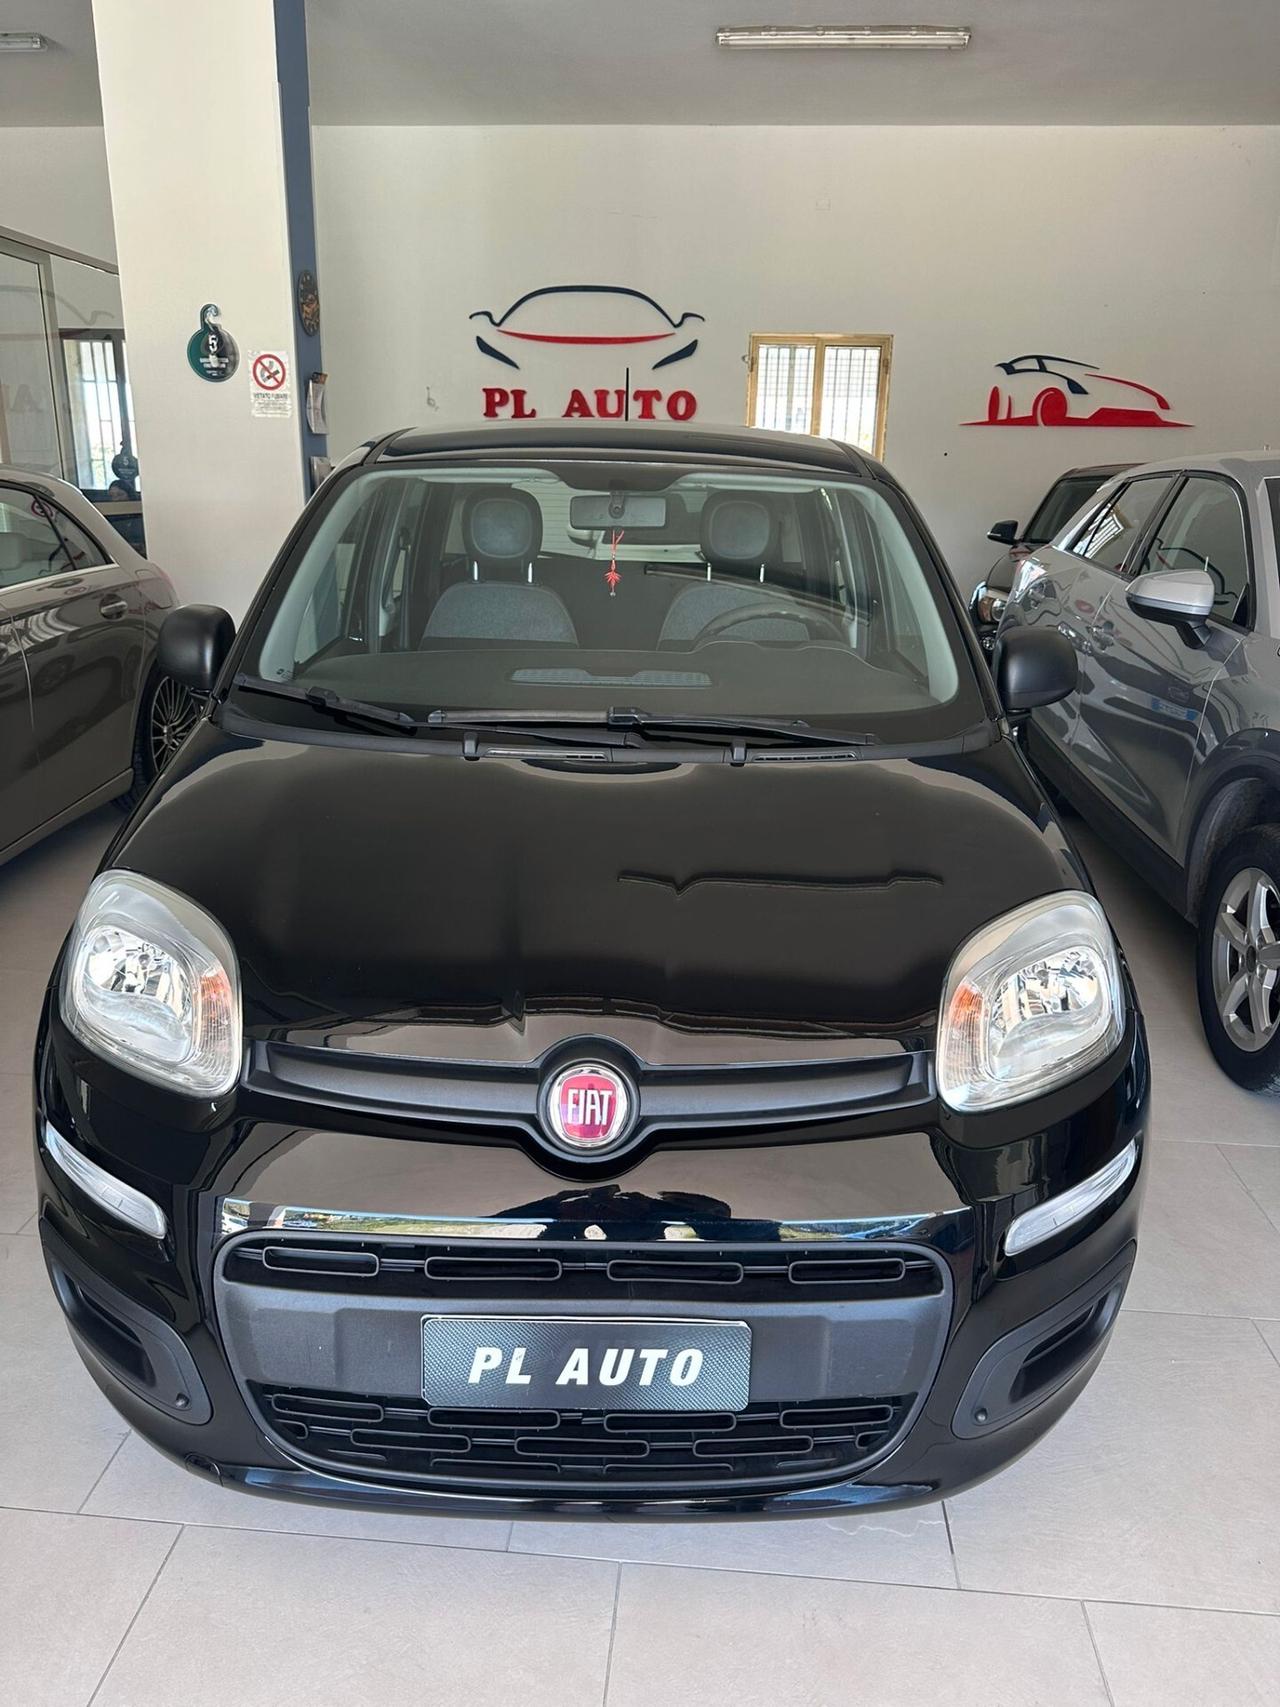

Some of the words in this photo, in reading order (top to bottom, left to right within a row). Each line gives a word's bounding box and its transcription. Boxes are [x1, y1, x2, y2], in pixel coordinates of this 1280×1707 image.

[208, 334, 218, 353] 5
[482, 387, 537, 419] PL
[562, 389, 697, 421] AUTO
[567, 1088, 613, 1126] FIAT
[468, 1346, 533, 1385] PL
[555, 1347, 704, 1387] AUTO
